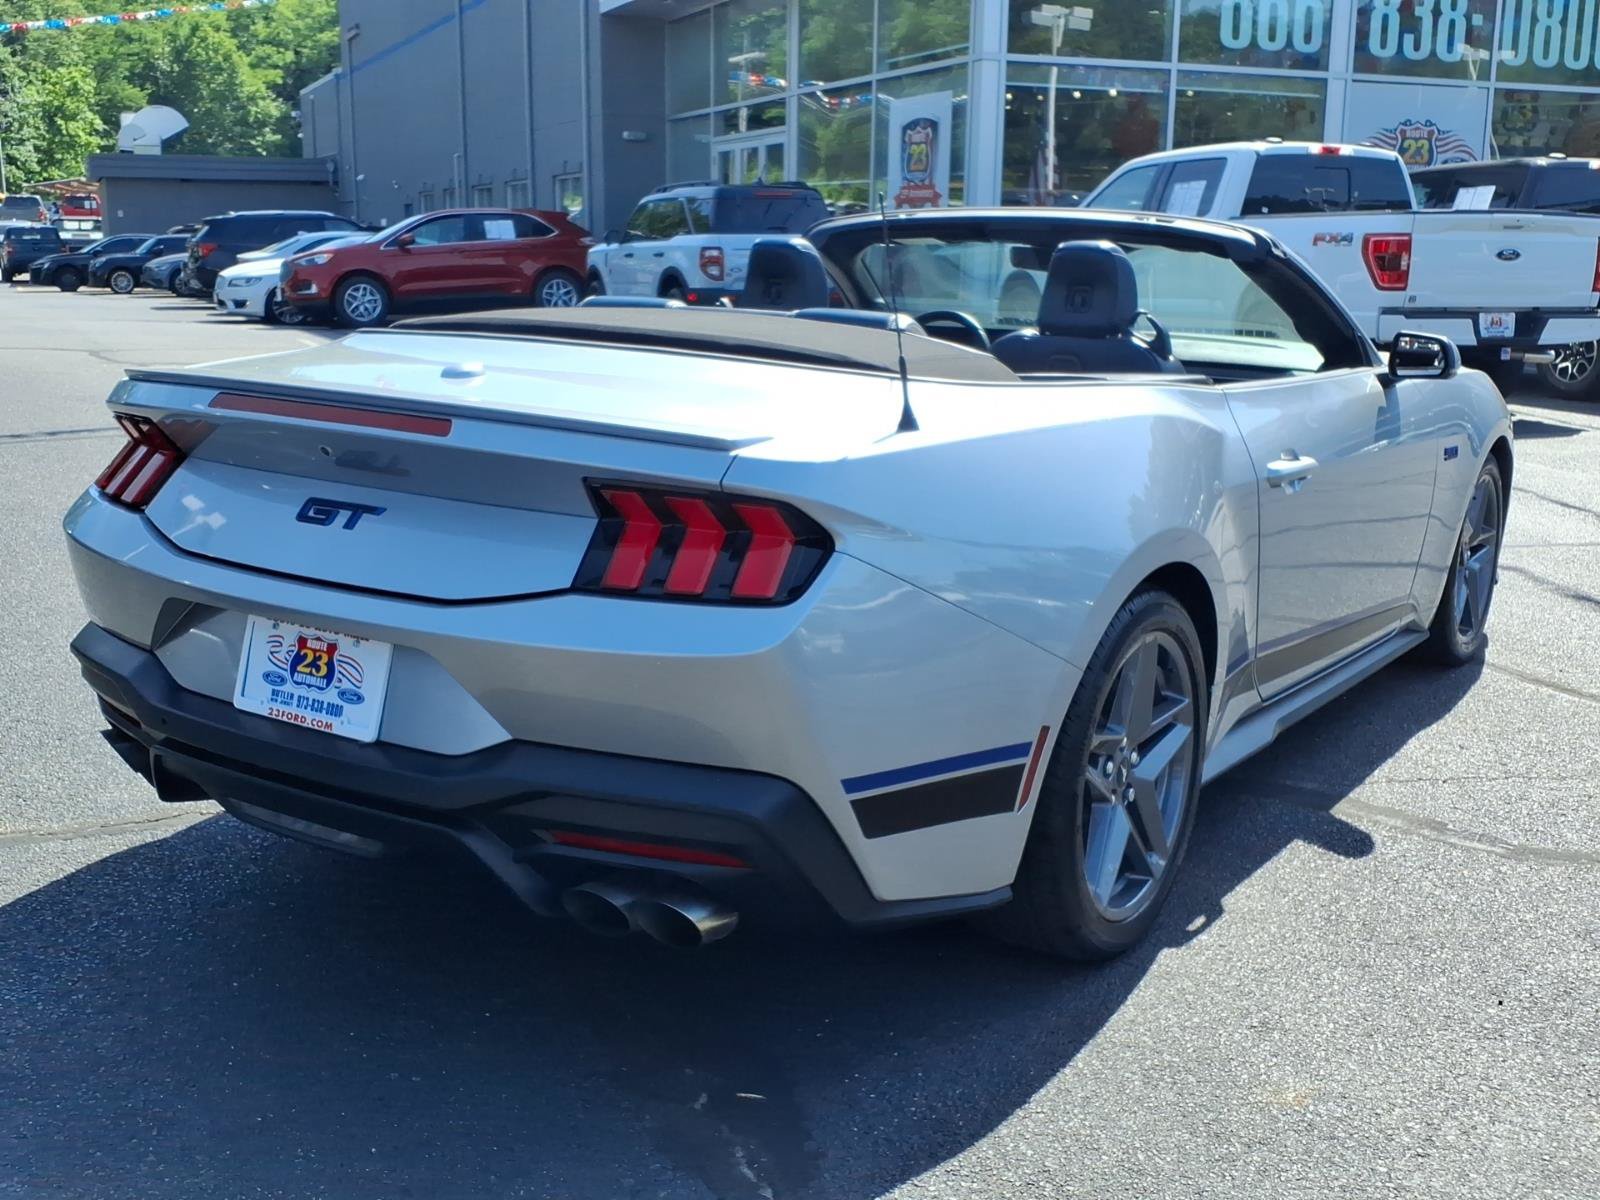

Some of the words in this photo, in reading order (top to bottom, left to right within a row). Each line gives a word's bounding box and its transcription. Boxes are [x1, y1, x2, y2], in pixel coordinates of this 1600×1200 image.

[1402, 139, 1430, 164] 23
[1312, 232, 1353, 246] FX4
[295, 496, 388, 531] GT
[306, 638, 328, 651] ROUTE
[296, 648, 329, 677] 23
[293, 672, 328, 688] AUTOMALL
[271, 688, 295, 700] BUTLER
[267, 707, 333, 731] 23FORD.COM
